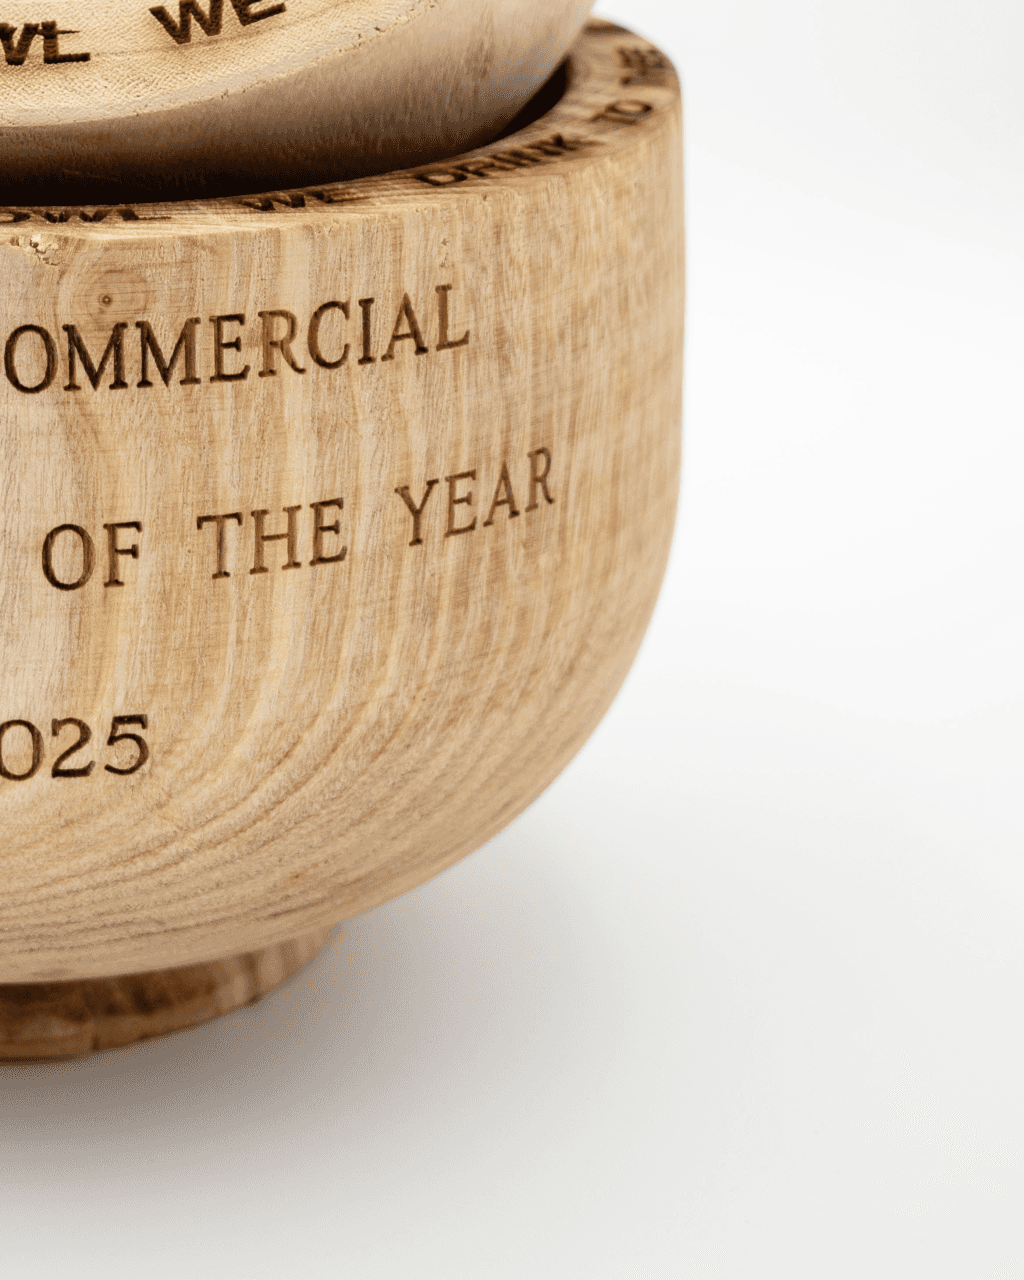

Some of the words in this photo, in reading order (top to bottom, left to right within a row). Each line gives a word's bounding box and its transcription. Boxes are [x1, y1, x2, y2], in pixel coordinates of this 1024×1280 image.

[41, 521, 143, 591] OF
[196, 498, 348, 579] THE
[395, 446, 555, 547] YEAR
